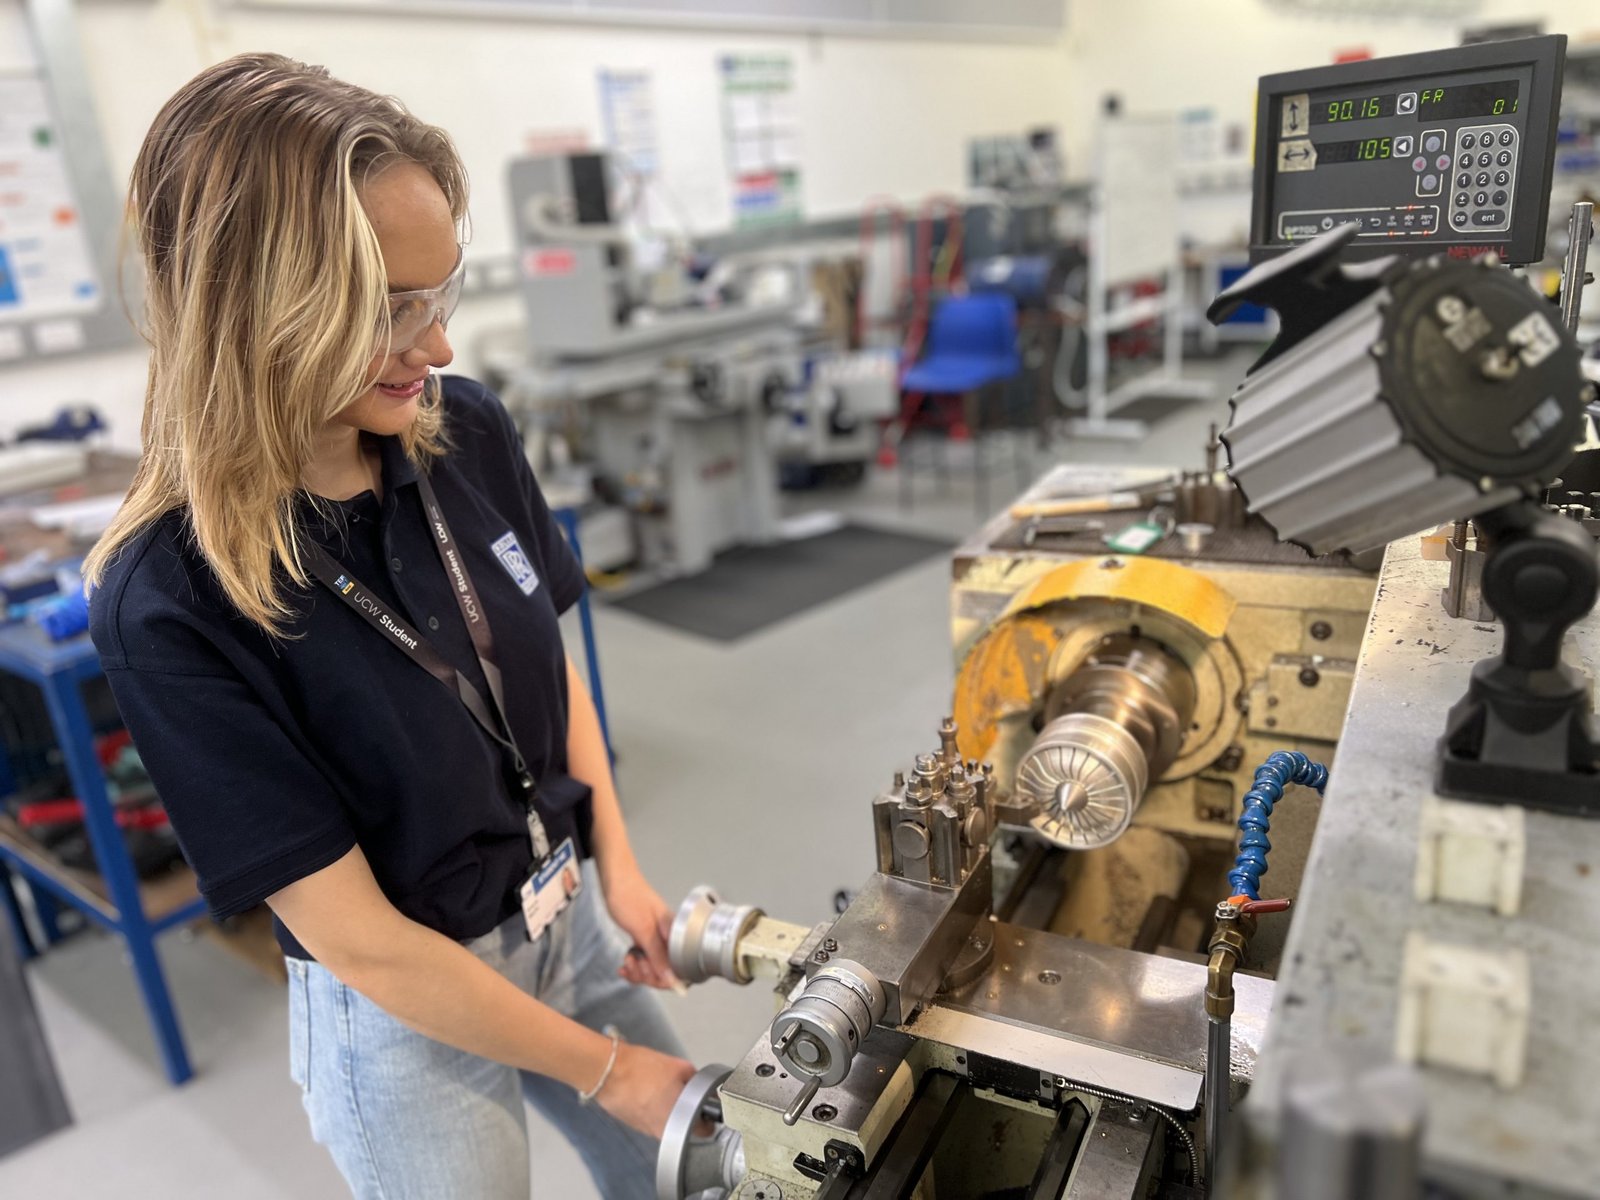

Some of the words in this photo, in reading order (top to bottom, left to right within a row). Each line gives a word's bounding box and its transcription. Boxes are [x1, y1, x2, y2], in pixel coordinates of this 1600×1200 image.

[1465, 137, 1472, 146] 7
[1483, 135, 1490, 145] 8
[1502, 133, 1509, 143] 9
[1358, 138, 1390, 160] 105
[1462, 156, 1469, 166] 4
[1481, 155, 1488, 164] 5
[1500, 153, 1507, 163] 6
[1479, 174, 1486, 184] 2
[1499, 173, 1505, 183] 3
[1478, 193, 1485, 203] 0
[1481, 214, 1495, 222] ent
[445, 549, 468, 593] Student
[462, 594, 480, 624] UCW
[353, 591, 382, 617] UCW
[379, 614, 418, 650] Student
